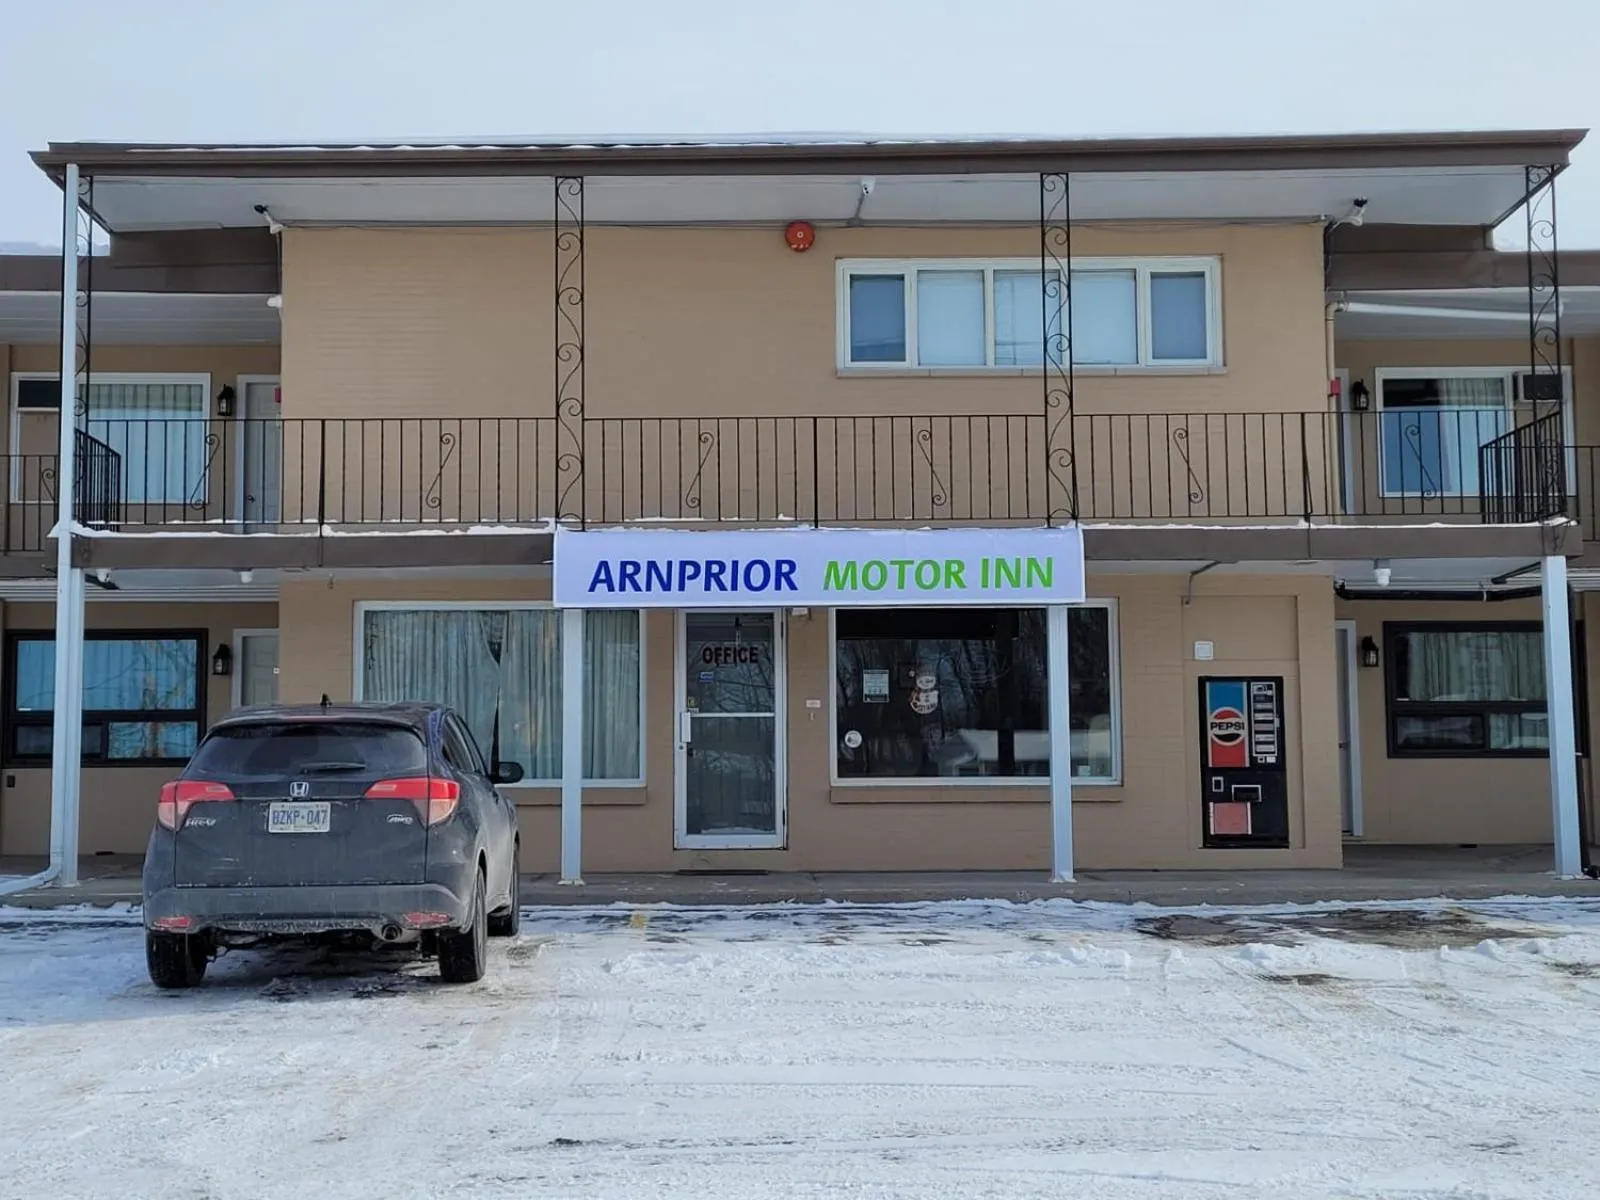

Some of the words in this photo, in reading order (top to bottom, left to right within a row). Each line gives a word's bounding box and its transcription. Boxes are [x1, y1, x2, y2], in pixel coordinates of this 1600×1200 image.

[587, 559, 799, 592] ARNPRIOR
[823, 559, 968, 591] MOTOR
[980, 557, 1053, 589] INN
[702, 646, 759, 664] OFFICE
[1210, 722, 1245, 731] PEPSI
